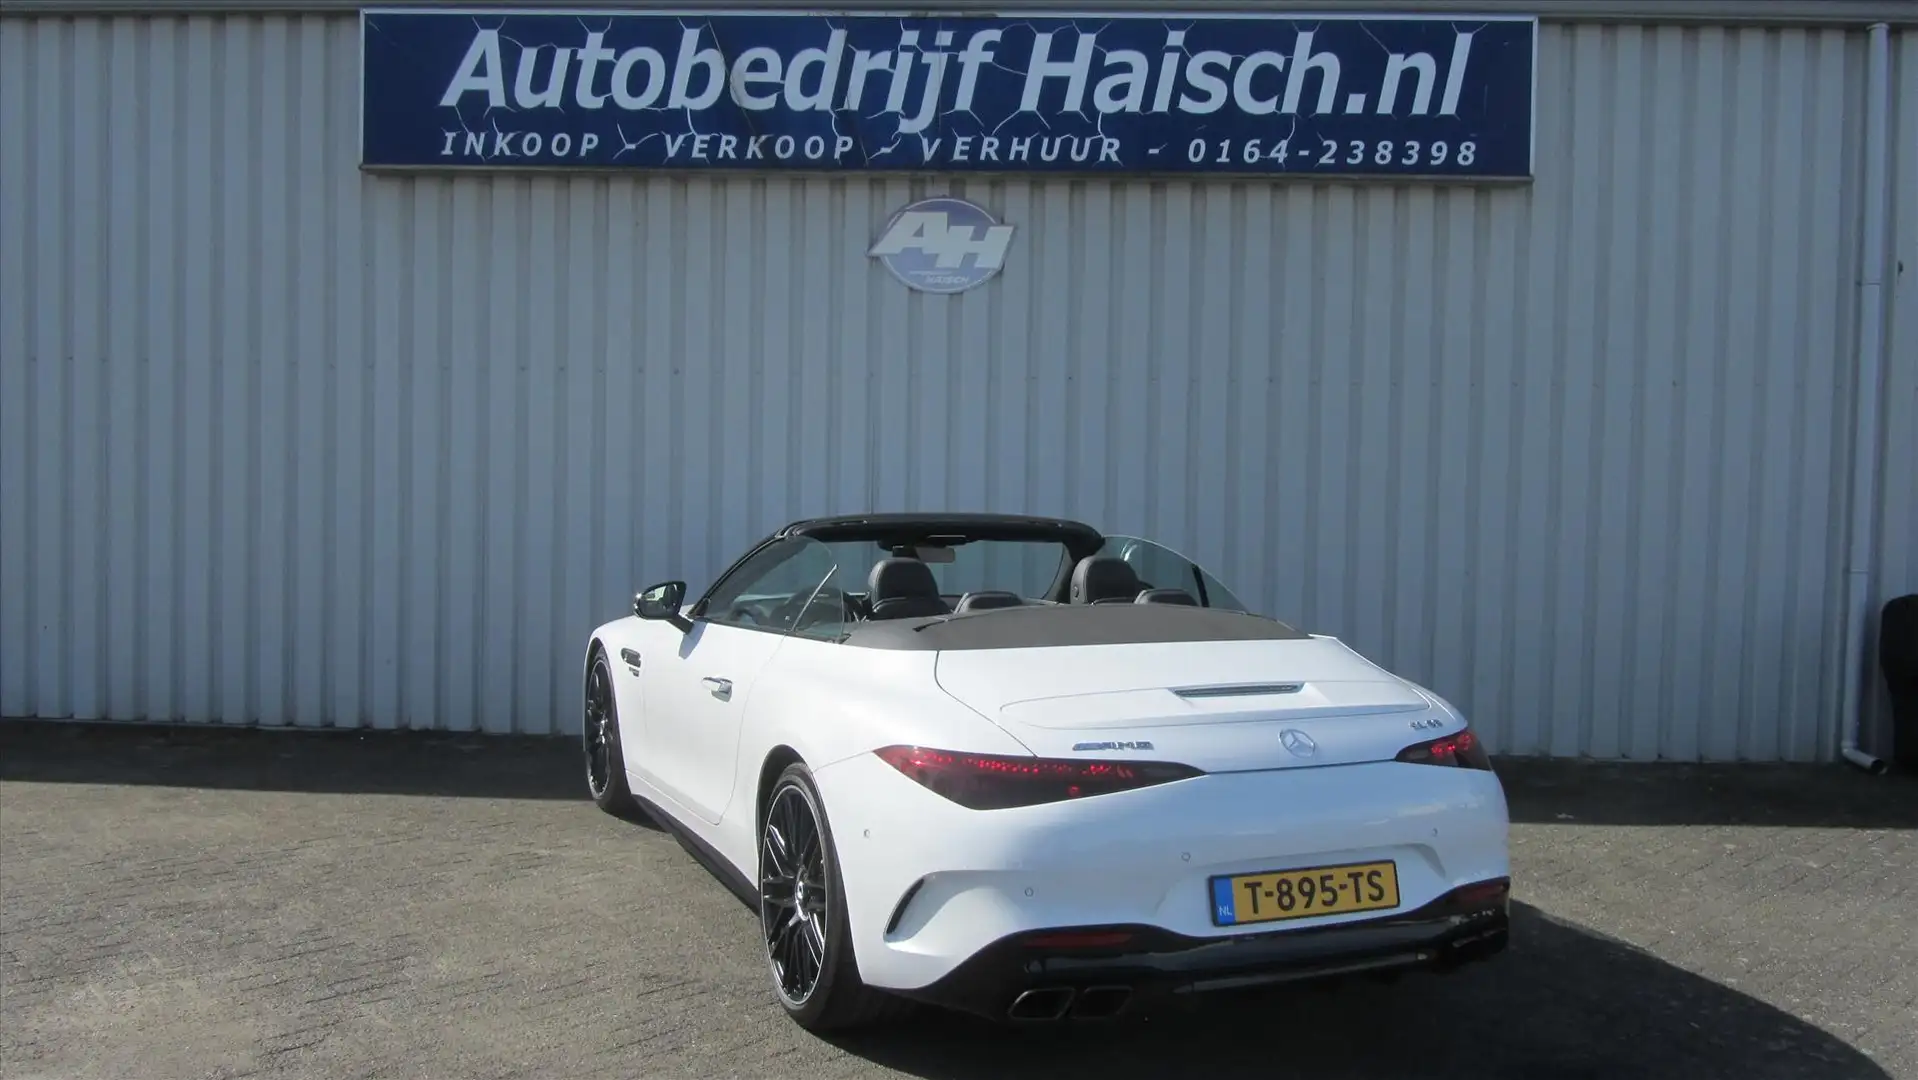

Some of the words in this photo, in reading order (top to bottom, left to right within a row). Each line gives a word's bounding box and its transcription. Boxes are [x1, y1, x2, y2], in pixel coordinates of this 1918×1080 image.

[439, 28, 1001, 133] Autobedrijf
[1018, 30, 1474, 115] Haisch.nl
[440, 131, 601, 157] INKOOP
[664, 133, 855, 160] VERKOOP
[921, 134, 1121, 163] VERHUUR
[1188, 137, 1477, 166] 0164-238398
[867, 211, 1014, 269] AH
[1218, 905, 1233, 916] NL
[1244, 870, 1385, 914] T-895-TS
